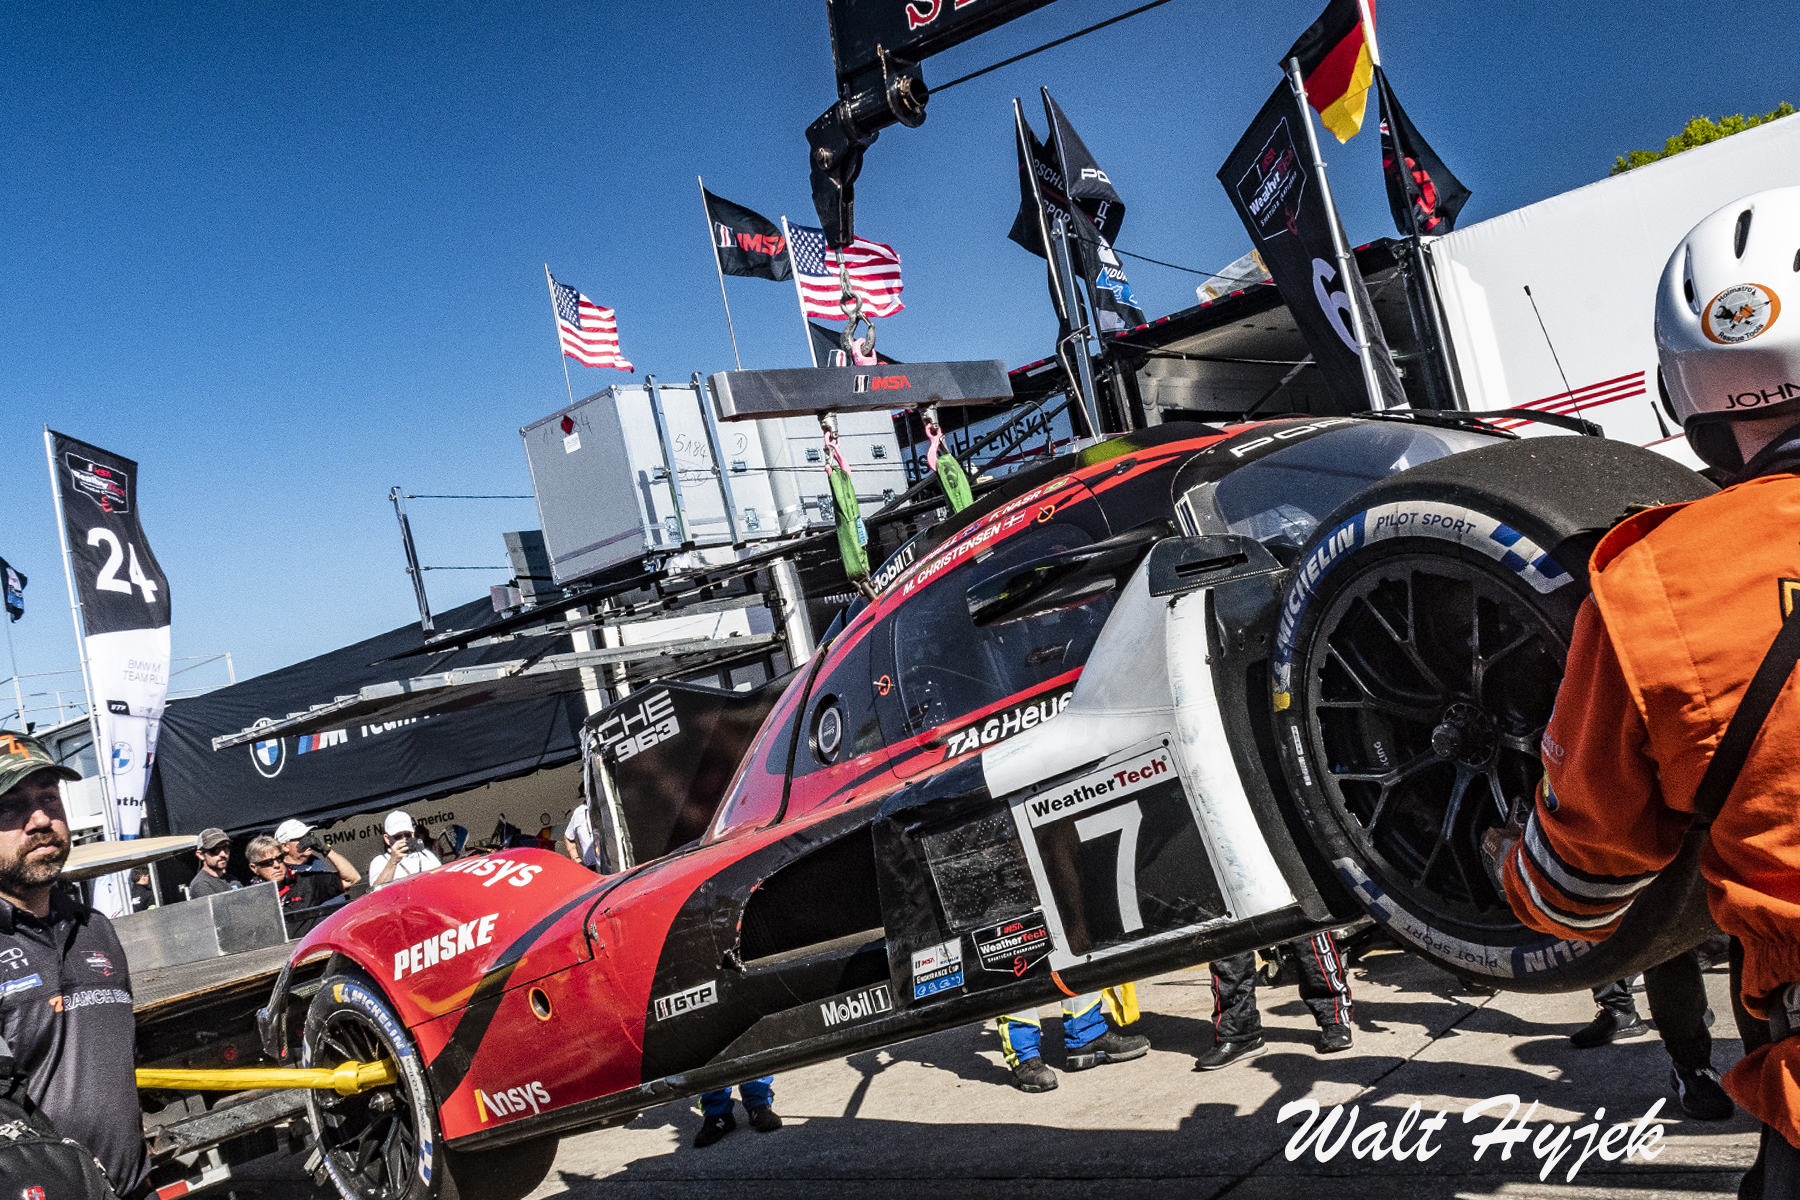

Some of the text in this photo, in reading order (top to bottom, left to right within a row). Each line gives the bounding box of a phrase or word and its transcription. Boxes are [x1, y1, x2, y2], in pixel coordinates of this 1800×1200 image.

[1312, 257, 1362, 356] 6
[1718, 323, 1764, 342] Rescue Tools
[871, 375, 911, 391] IMSA
[1002, 489, 1042, 514] NASR
[1376, 512, 1476, 533] PILOT SPORT
[87, 527, 158, 603] 24
[902, 523, 1001, 597] M. CHRISTENSEN
[1276, 522, 1354, 651] MICHELIN
[122, 669, 149, 682] TEAM
[615, 715, 680, 763] 963
[1031, 757, 1167, 818] WeatherTech
[323, 829, 356, 846] BMW
[359, 827, 372, 840] of
[1074, 799, 1144, 934] 7
[393, 912, 499, 981] PENSKE
[980, 929, 1047, 955] WeatherTech
[1403, 924, 1498, 968] PILOT SPORT
[1523, 940, 1598, 973] ELIN
[351, 989, 405, 1050] MICHELIN
[674, 987, 712, 1011] GTP
[820, 994, 872, 1026] Mobil
[475, 1080, 551, 1123] Ansys
